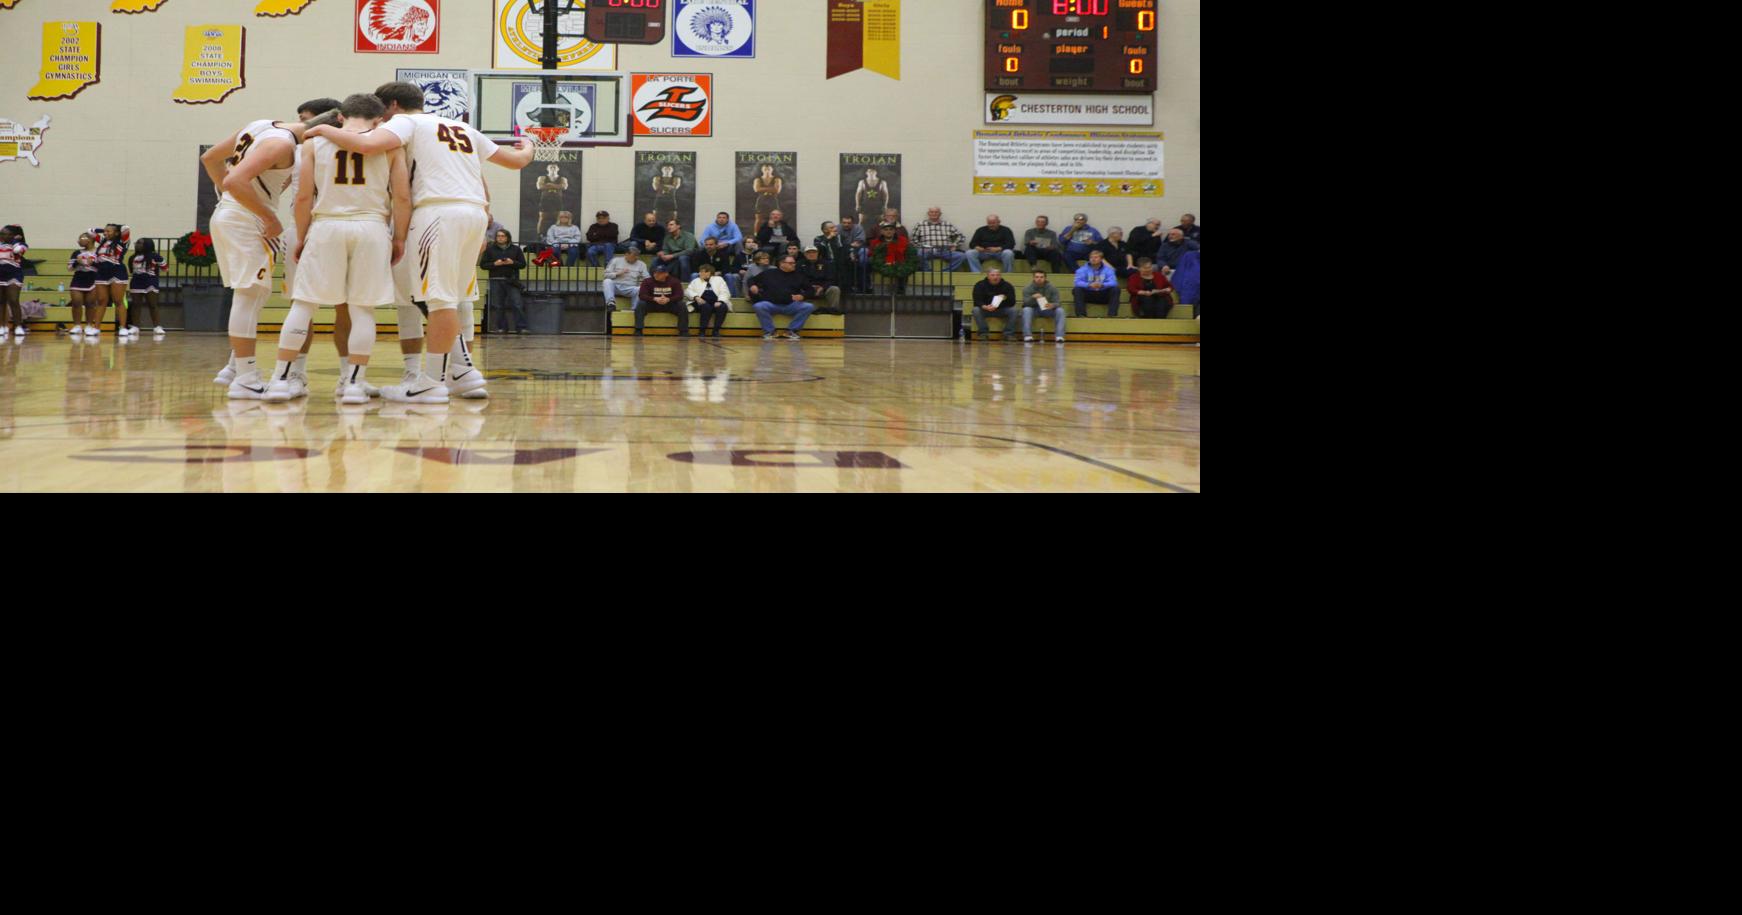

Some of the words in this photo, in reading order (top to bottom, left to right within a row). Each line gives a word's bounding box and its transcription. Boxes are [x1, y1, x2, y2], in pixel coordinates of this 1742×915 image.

[1053, 0, 1108, 15] 8:00
[1012, 9, 1029, 29] 0
[1138, 11, 1155, 31] 0
[1056, 27, 1089, 37] period
[377, 43, 417, 51] INDIANS
[998, 44, 1022, 53] fouls
[1056, 44, 1088, 55] player
[1124, 45, 1147, 55] fouls
[1006, 57, 1018, 72] 0
[1130, 58, 1143, 74] 0
[45, 72, 93, 80] GYMNASTICS
[1056, 78, 1088, 87] weight
[1021, 104, 1082, 114] CHESTERTON
[1085, 105, 1108, 114] HIGH
[1112, 105, 1149, 114] SCHOOL
[436, 123, 474, 154] 45
[640, 152, 692, 161] TROJAN
[740, 153, 793, 162] TROJAN
[844, 155, 897, 164] TROJAN
[334, 150, 367, 185] 11
[257, 267, 267, 280] C
